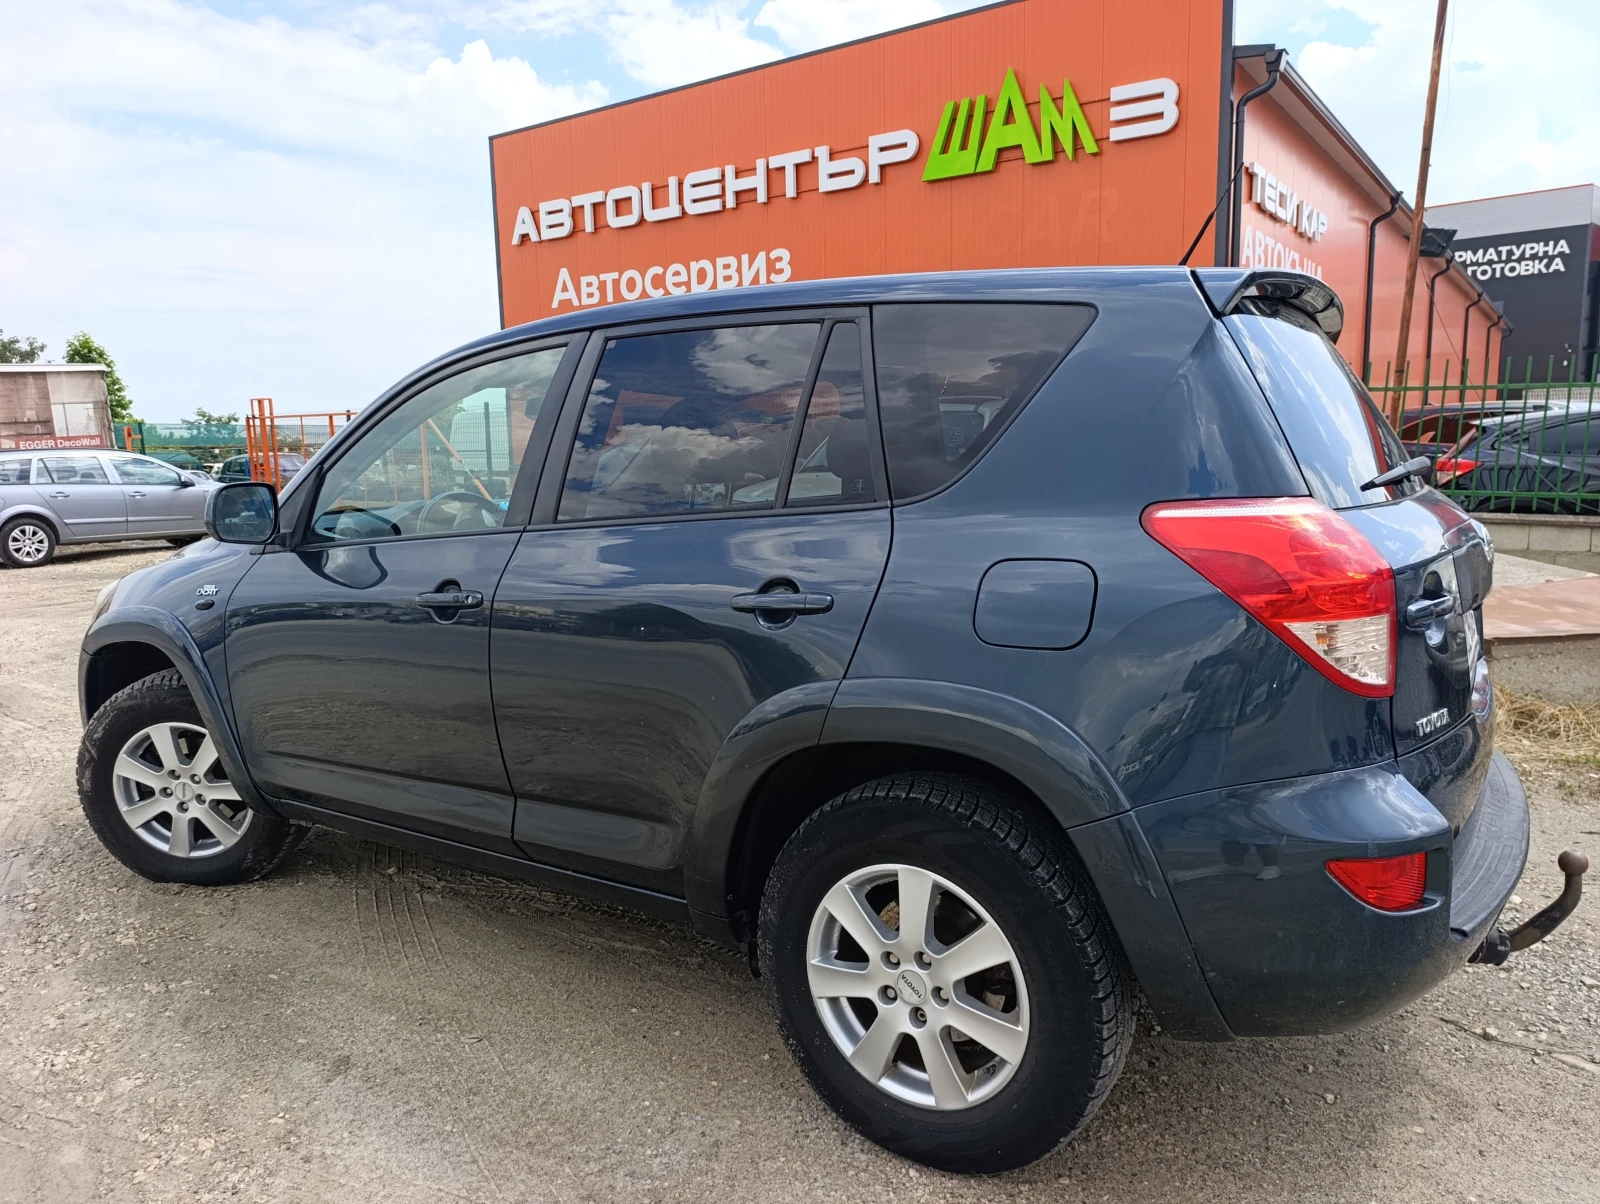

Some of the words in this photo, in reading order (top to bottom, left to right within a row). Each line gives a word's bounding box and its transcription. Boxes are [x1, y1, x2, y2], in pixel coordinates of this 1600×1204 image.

[511, 128, 920, 245] АВТОЦЕНТЪР
[921, 66, 1099, 182] ШАМ
[1249, 161, 1297, 227] ТЕСИ
[1297, 199, 1328, 243] КАР
[551, 248, 792, 308] Автосервиз
[19, 440, 55, 450] EGGER
[57, 437, 100, 448] DecoWall
[1414, 708, 1450, 737] TOYOTA
[901, 974, 922, 999] TOYOTA
